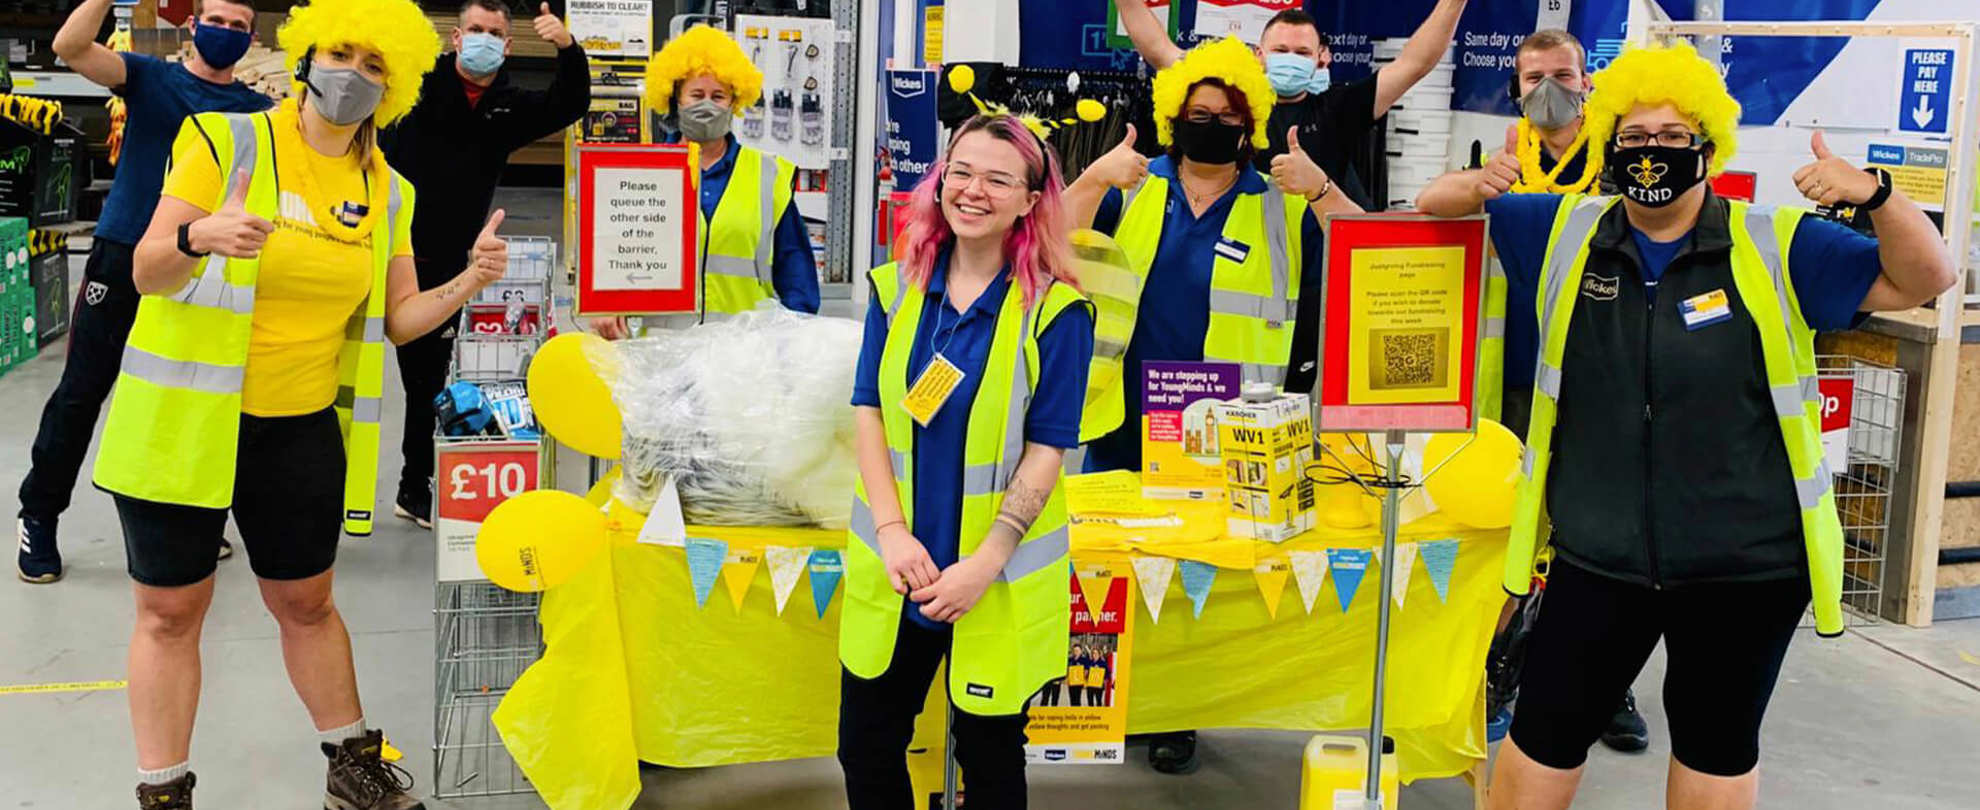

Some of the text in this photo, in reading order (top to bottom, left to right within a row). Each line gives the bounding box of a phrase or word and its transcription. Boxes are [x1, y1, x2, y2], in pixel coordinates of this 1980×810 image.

[607, 2, 617, 10] TO
[1326, 33, 1346, 46] ext
[1464, 32, 1489, 47] Same
[1489, 34, 1507, 48] day
[1721, 37, 1734, 54] &
[1463, 51, 1517, 71] Choose you
[1912, 51, 1948, 65] PLEASE
[1917, 66, 1938, 79] PAY
[893, 77, 922, 90] Wickes
[1913, 80, 1939, 93] HERE
[1871, 149, 1901, 160] Wickes
[900, 160, 928, 174] other
[619, 180, 658, 192] Please
[1627, 185, 1673, 203] KIND
[610, 197, 667, 209] queue the
[609, 212, 667, 223] other side
[621, 228, 655, 239] of the
[607, 259, 668, 272] Thank you
[1148, 369, 1219, 384] We are stepping up
[1148, 381, 1226, 394] for YoungMinds & we
[1147, 393, 1167, 404] need
[1287, 418, 1311, 438] WV1
[1231, 428, 1266, 446] WV1
[450, 461, 527, 501] £10
